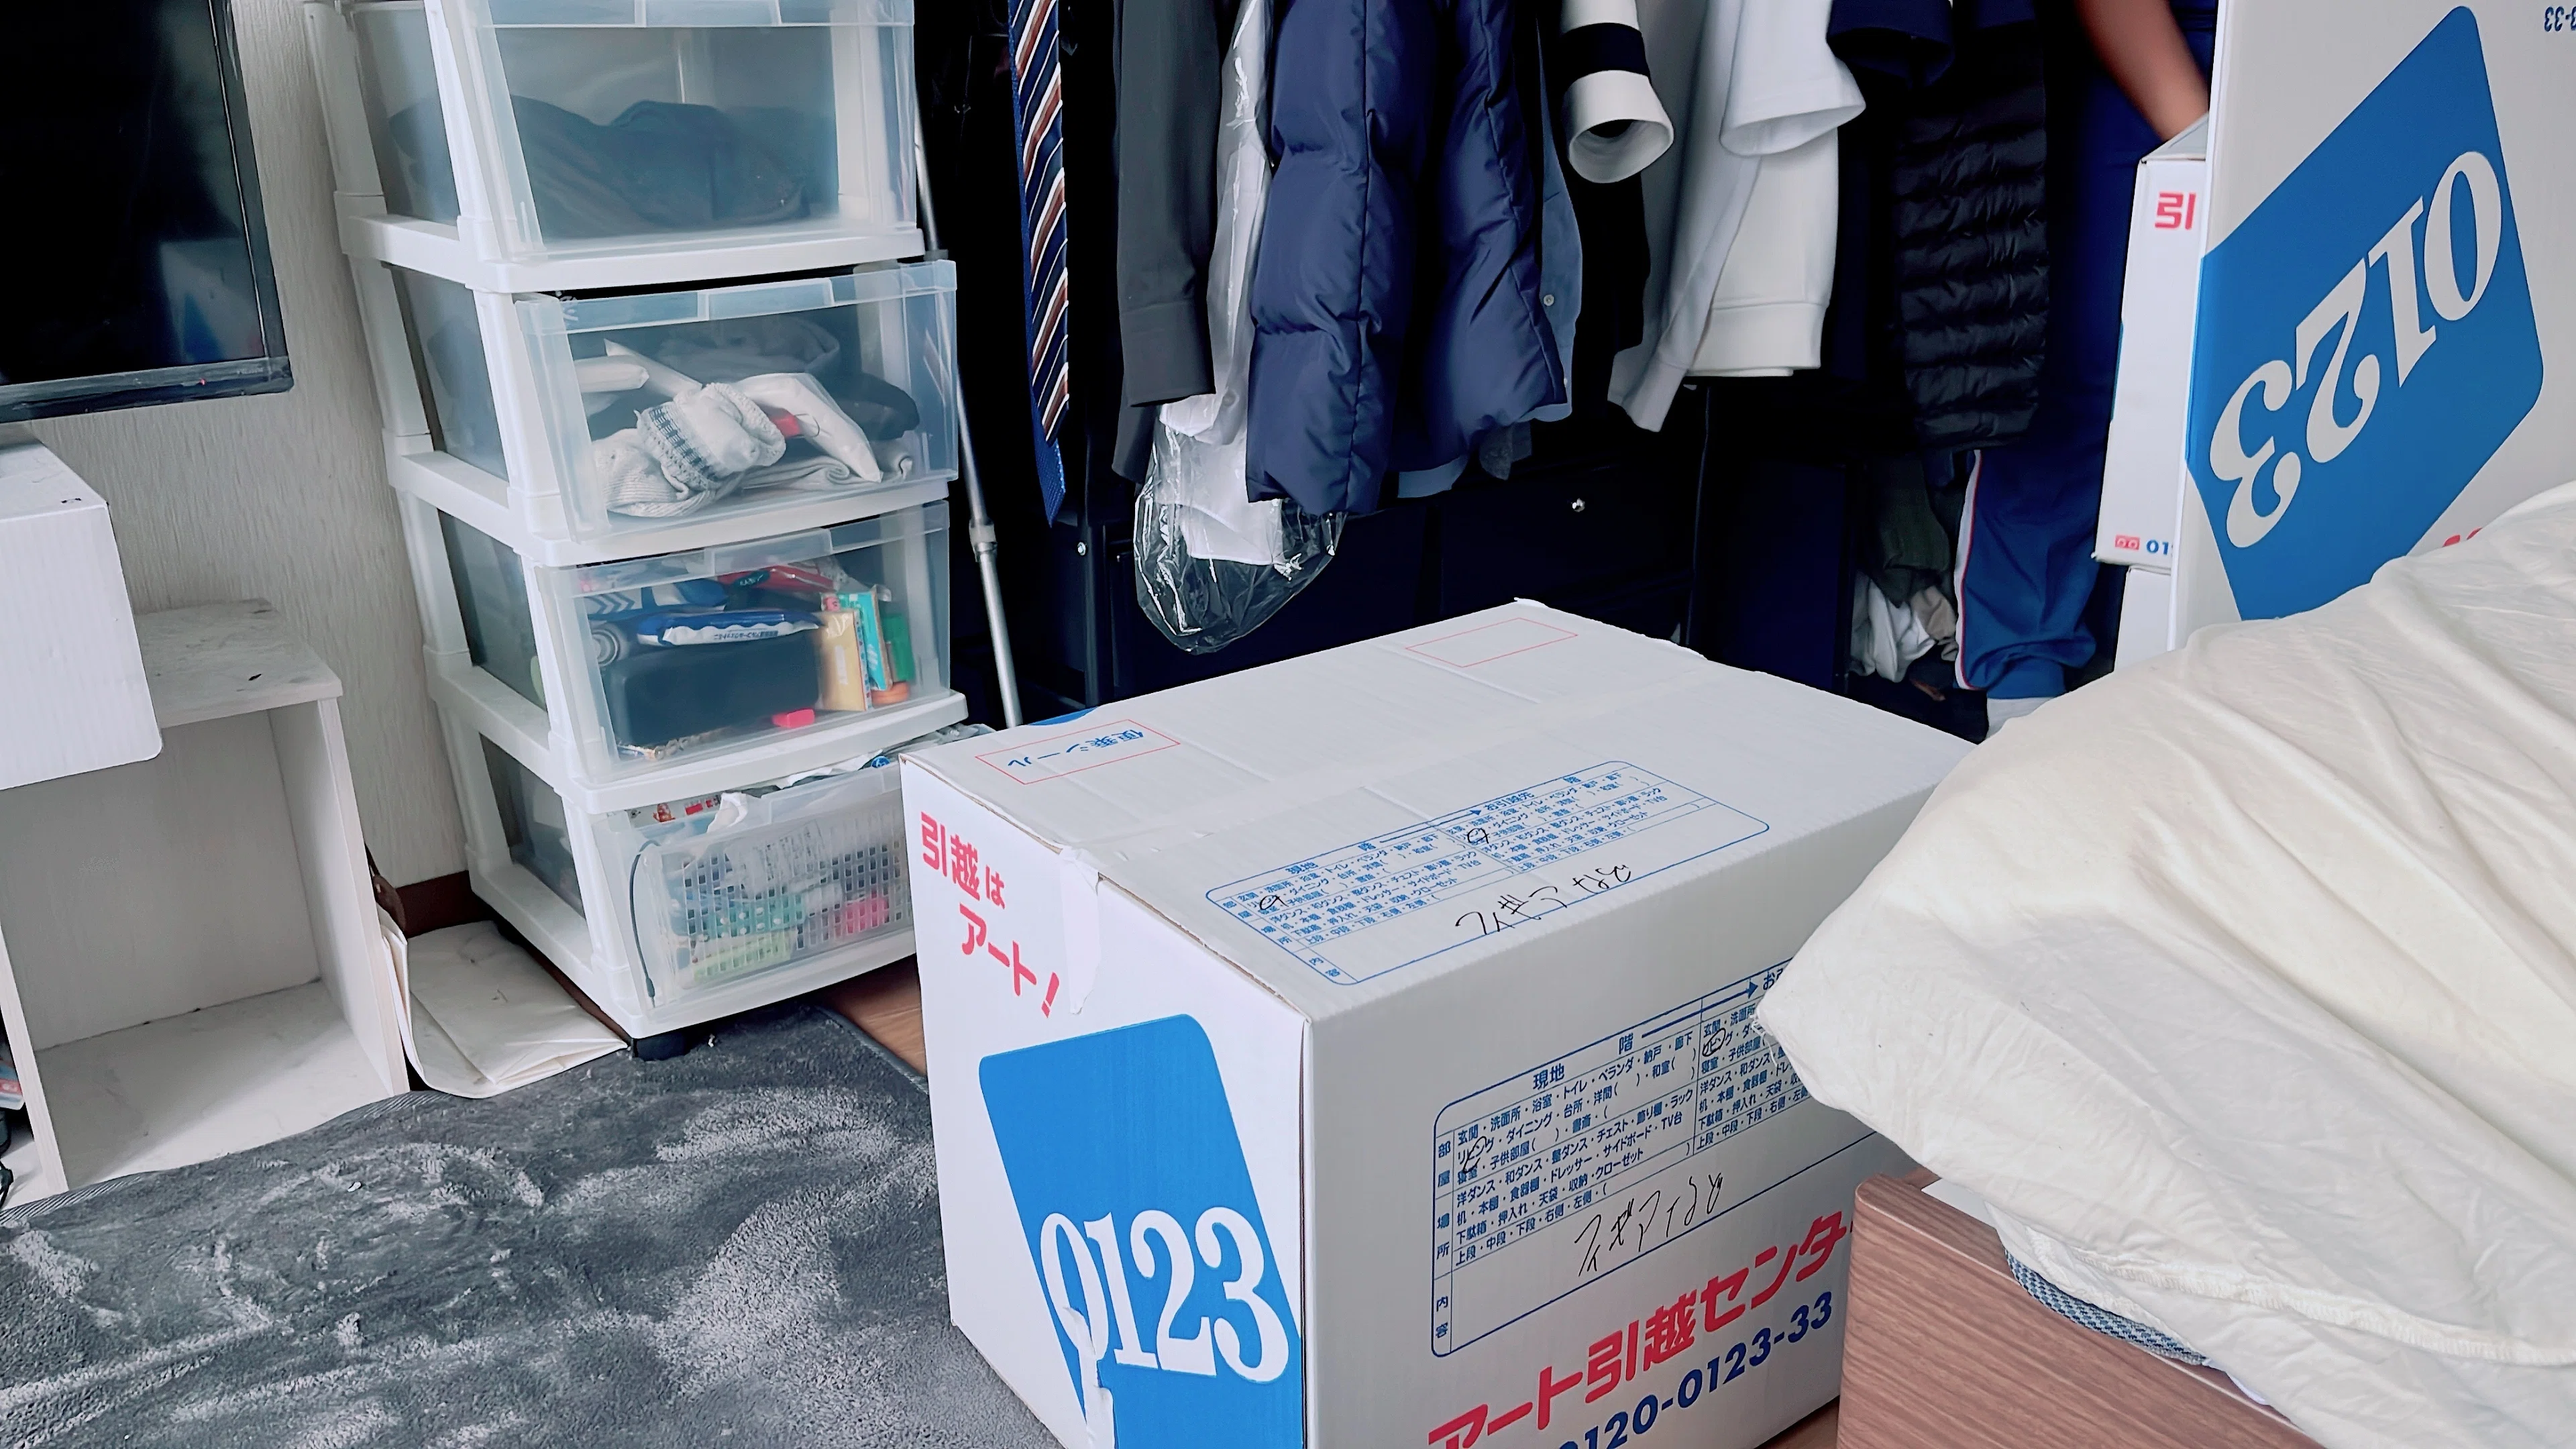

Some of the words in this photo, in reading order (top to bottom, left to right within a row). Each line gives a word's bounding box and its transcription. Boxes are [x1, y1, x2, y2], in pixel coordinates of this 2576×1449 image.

[2155, 192, 2196, 229] 引
[2210, 151, 2502, 548] 0123
[2146, 539, 2174, 555] 01
[921, 811, 1006, 910] 引越は
[1533, 1062, 1564, 1091] 現地
[1619, 1032, 1633, 1054] 階
[1699, 1070, 1802, 1130] 下駄箱・押入れ・天袋・収
[1040, 1207, 1289, 1383] 0123
[1429, 1210, 1853, 1449] アート引越センタ
[1558, 1291, 1832, 1449] 120-0123-33
